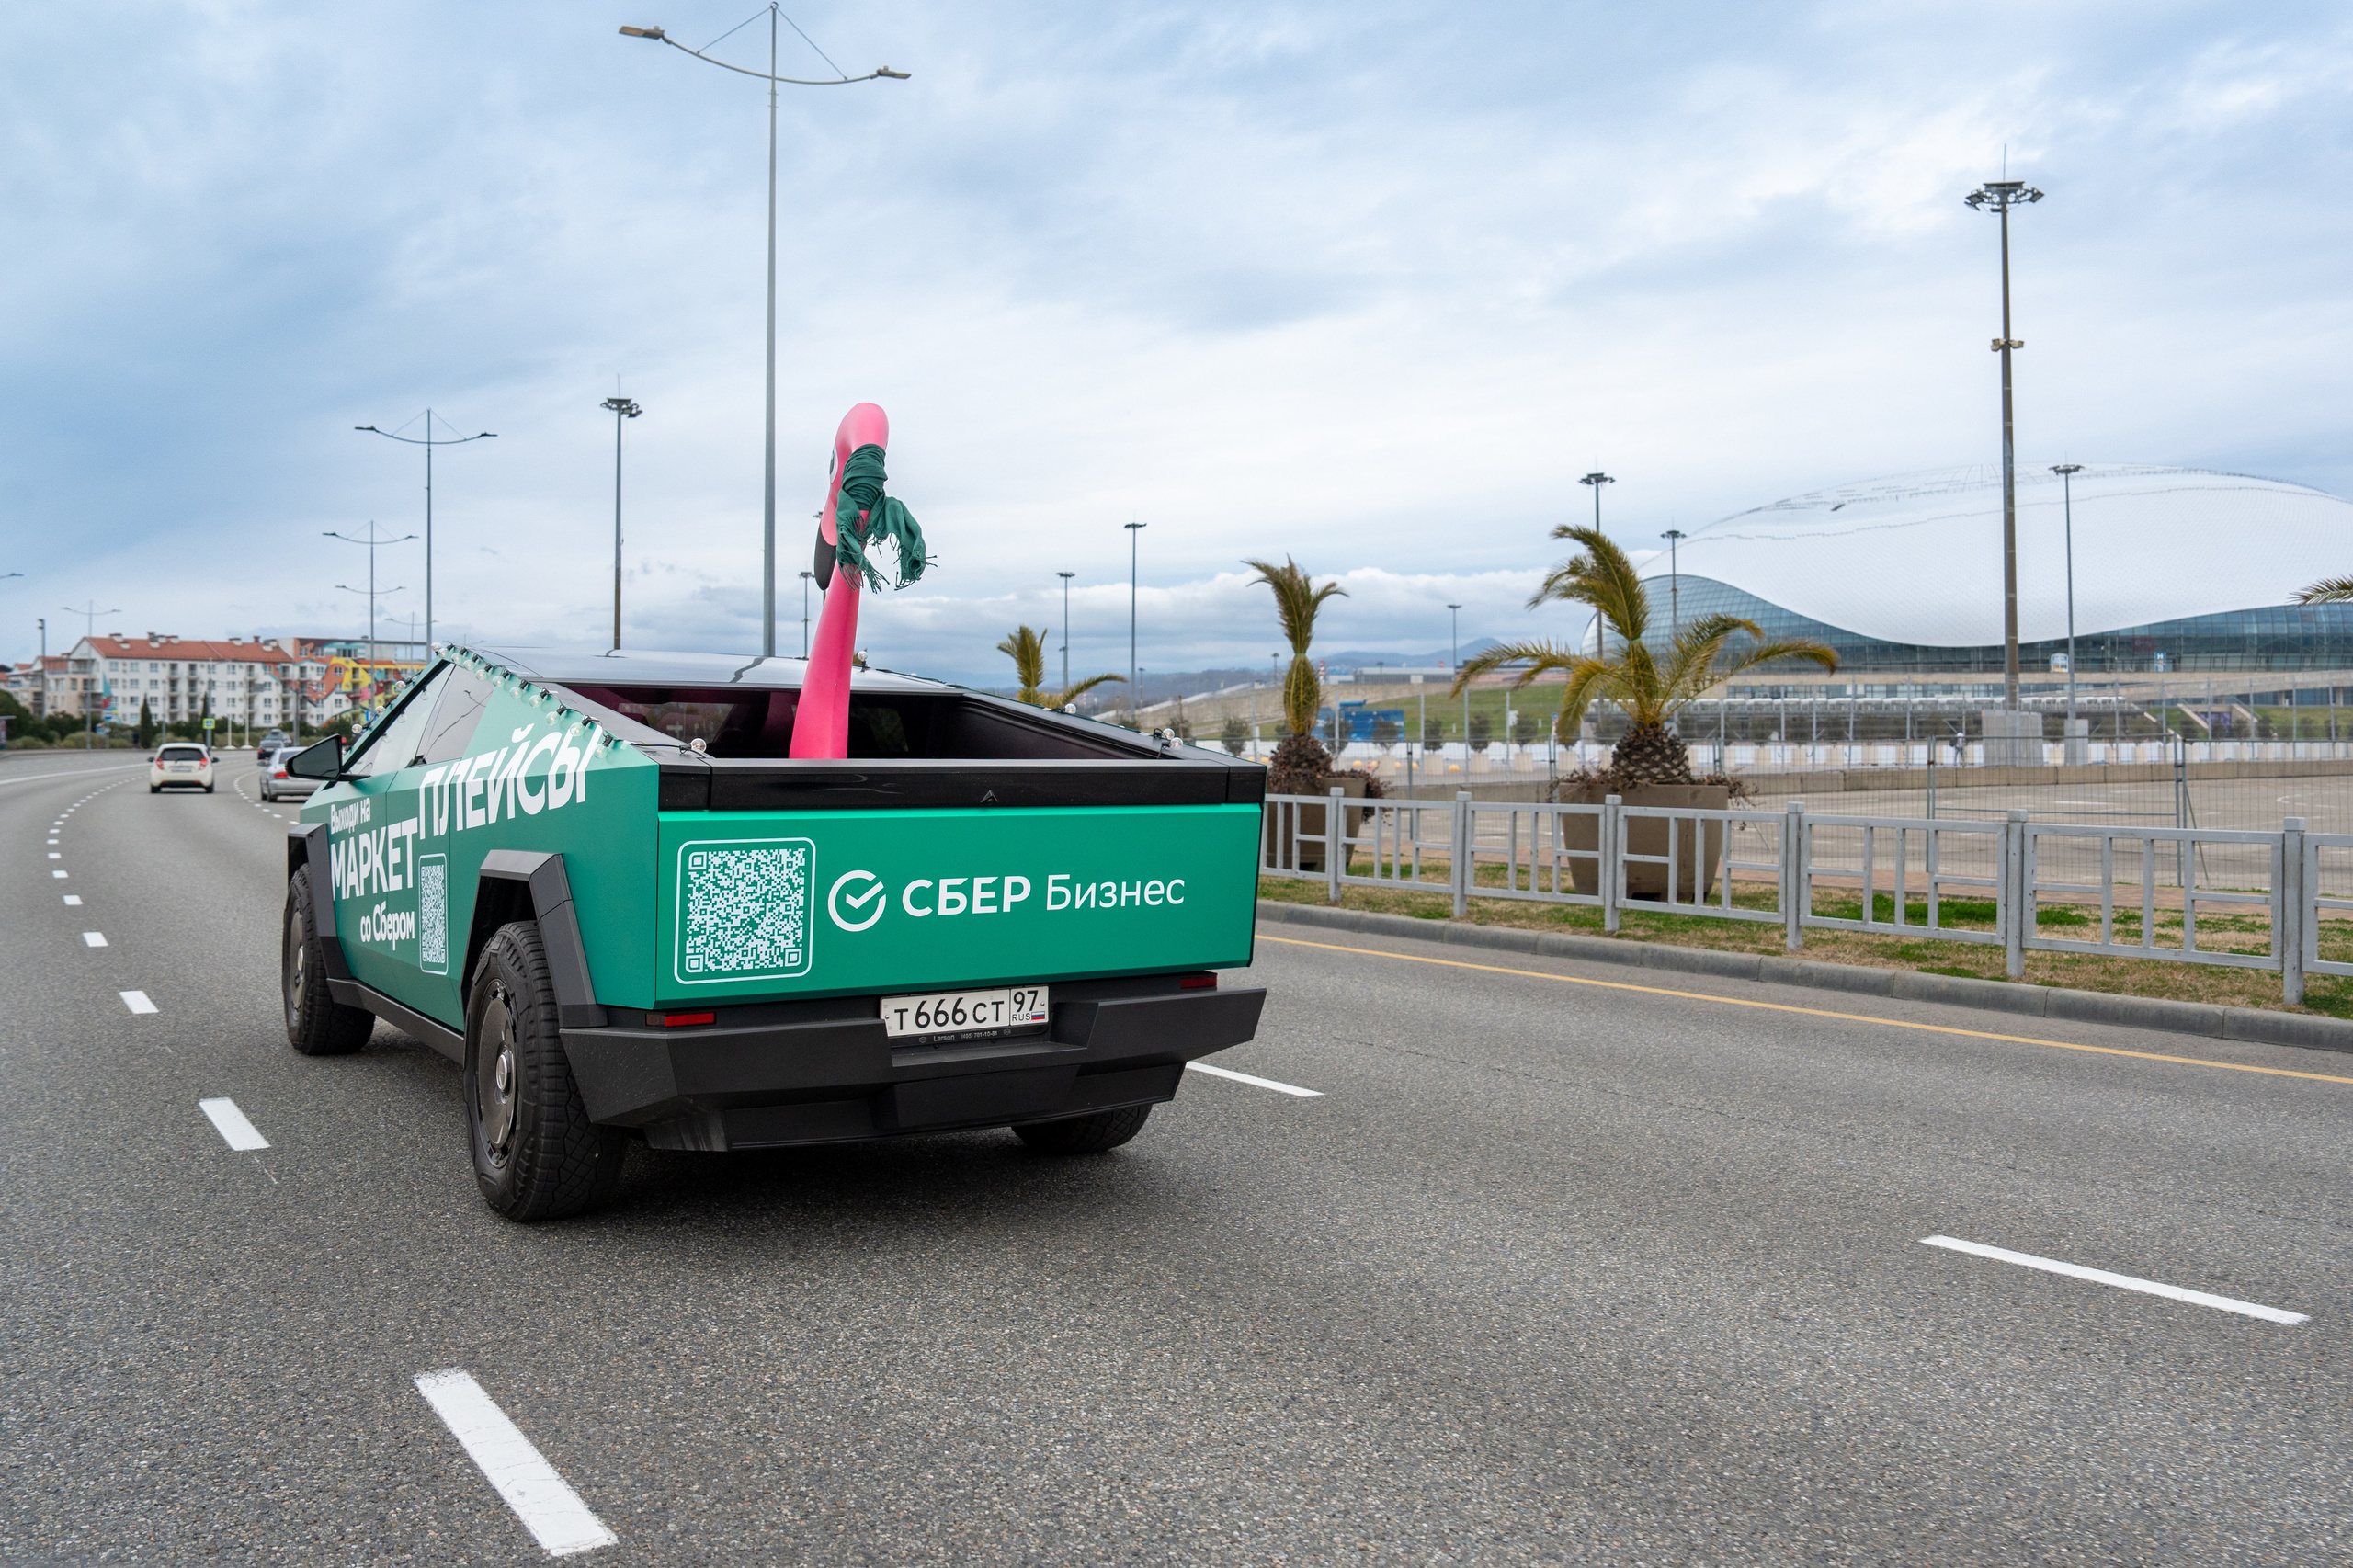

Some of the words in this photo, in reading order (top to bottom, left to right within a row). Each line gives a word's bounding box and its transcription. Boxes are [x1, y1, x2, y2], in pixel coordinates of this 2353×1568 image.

[419, 723, 603, 840] ПЛЕЙСЫ
[331, 804, 358, 835] Выходи
[360, 798, 370, 824] на
[331, 817, 418, 901] МАРКЕТ
[902, 876, 1031, 917] СБЕР
[1046, 874, 1185, 911] Бизнес
[360, 915, 371, 942] со
[372, 901, 415, 951] Сбером
[894, 997, 1005, 1030] Т666СТ
[1013, 990, 1039, 1013] 97
[1012, 1013, 1030, 1022] RUS
